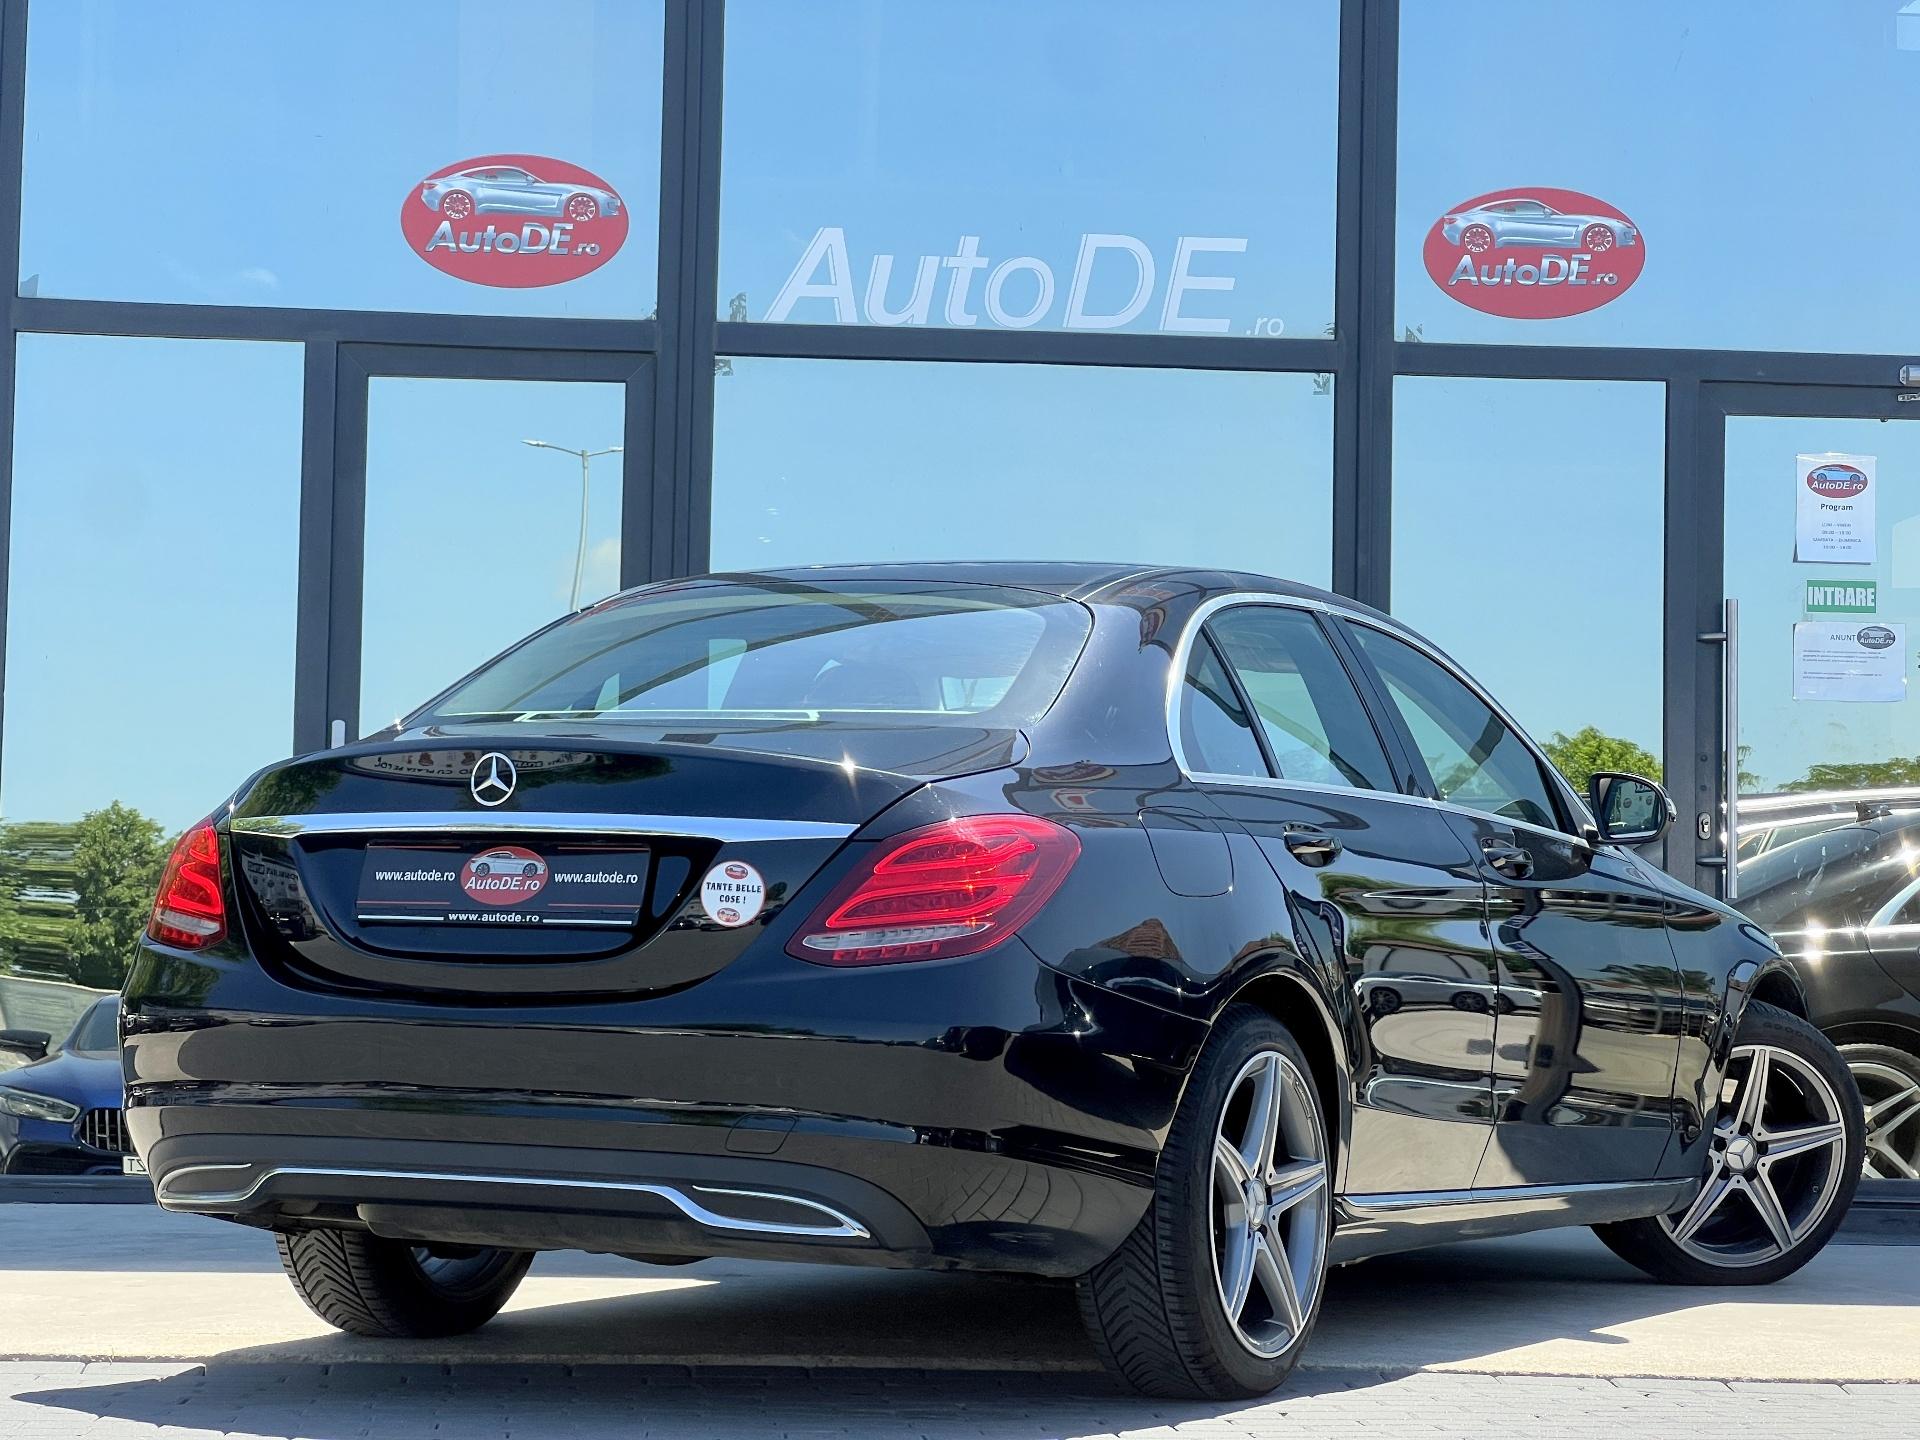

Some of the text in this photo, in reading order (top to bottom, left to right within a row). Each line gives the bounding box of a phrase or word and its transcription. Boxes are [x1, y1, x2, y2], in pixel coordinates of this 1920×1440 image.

[424, 221, 601, 257] AutoDE.ro
[1448, 253, 1619, 286] AutoDE.ro
[1811, 481, 1864, 491] AutoDE.ro
[1820, 503, 1854, 512] Program
[1807, 586, 1875, 607] INTRARE
[375, 869, 456, 881] www.autode.ro
[554, 871, 638, 884] www.autode.ro
[464, 876, 540, 891] AutoDE.ro
[706, 882, 762, 893] TANTE BELLE
[719, 895, 741, 904] COSE
[448, 913, 539, 922] www.autode.ro
